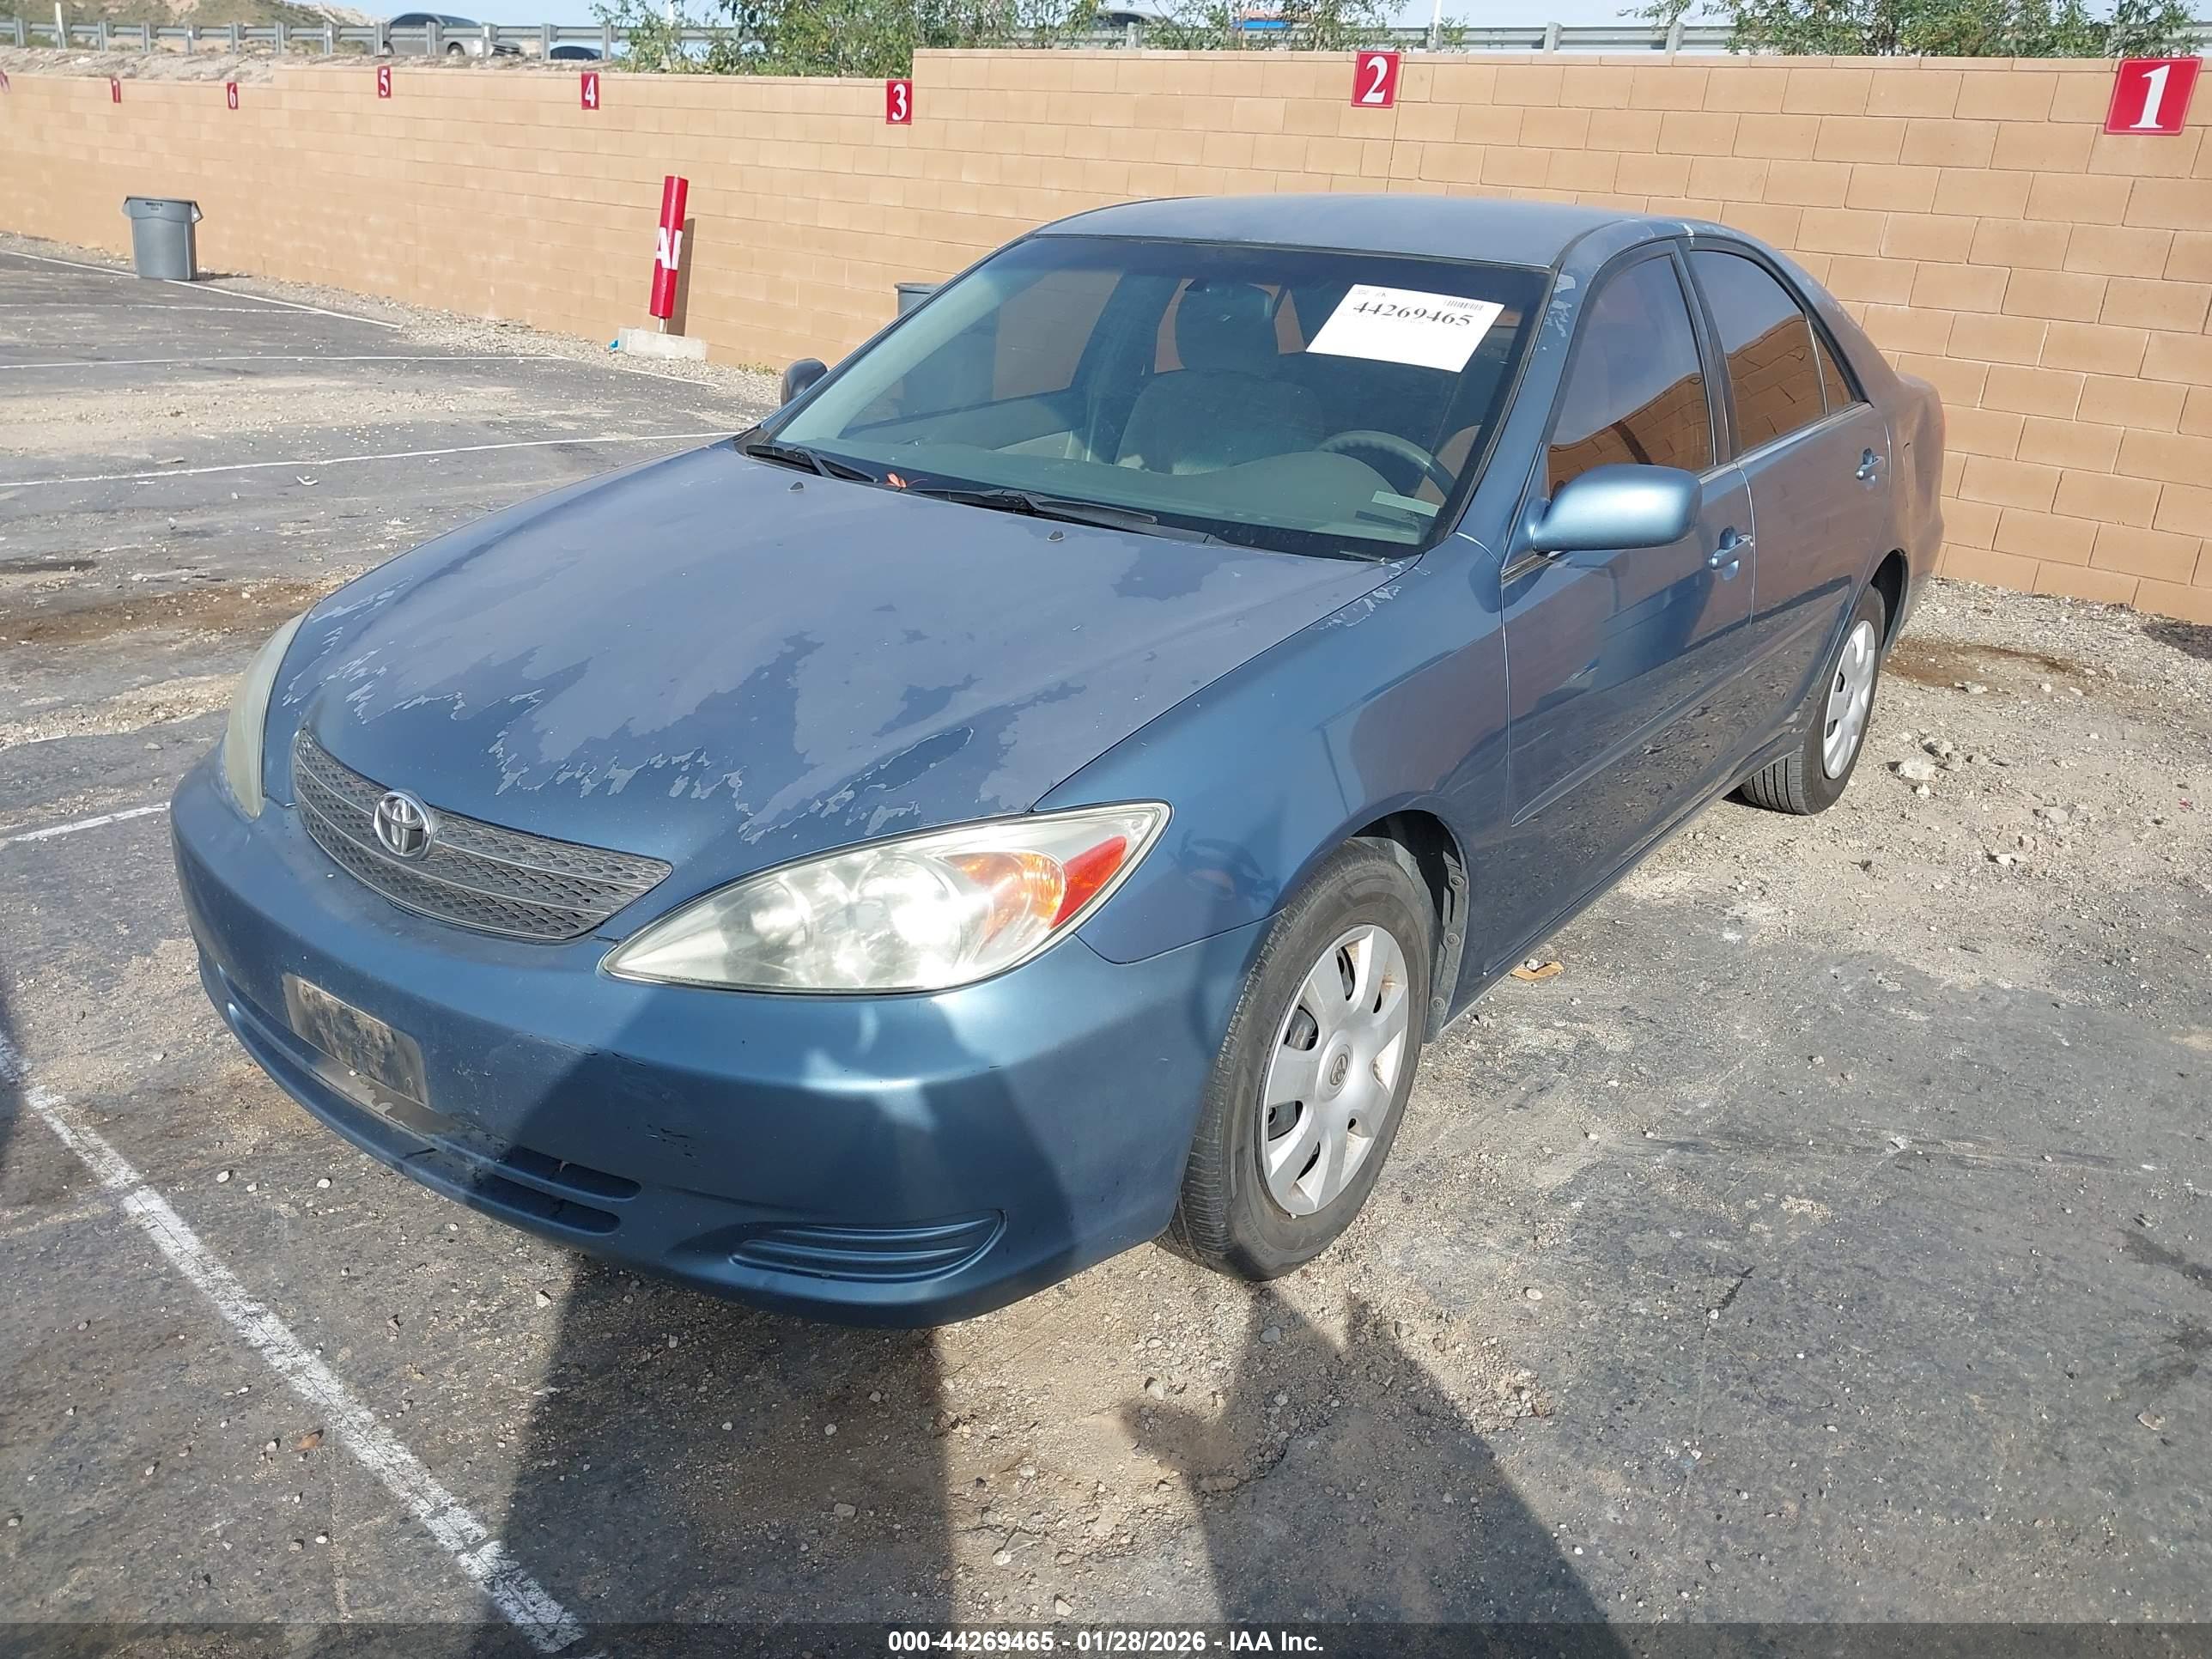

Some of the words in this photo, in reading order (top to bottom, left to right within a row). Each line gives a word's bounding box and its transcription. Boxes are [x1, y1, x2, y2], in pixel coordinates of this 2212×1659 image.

[380, 69, 388, 96] 5
[585, 76, 596, 107] 4
[1361, 55, 1389, 103] 2
[229, 84, 236, 108] 6
[892, 83, 907, 121] 3
[2130, 64, 2171, 129] 1
[1352, 301, 1474, 326] 44269465
